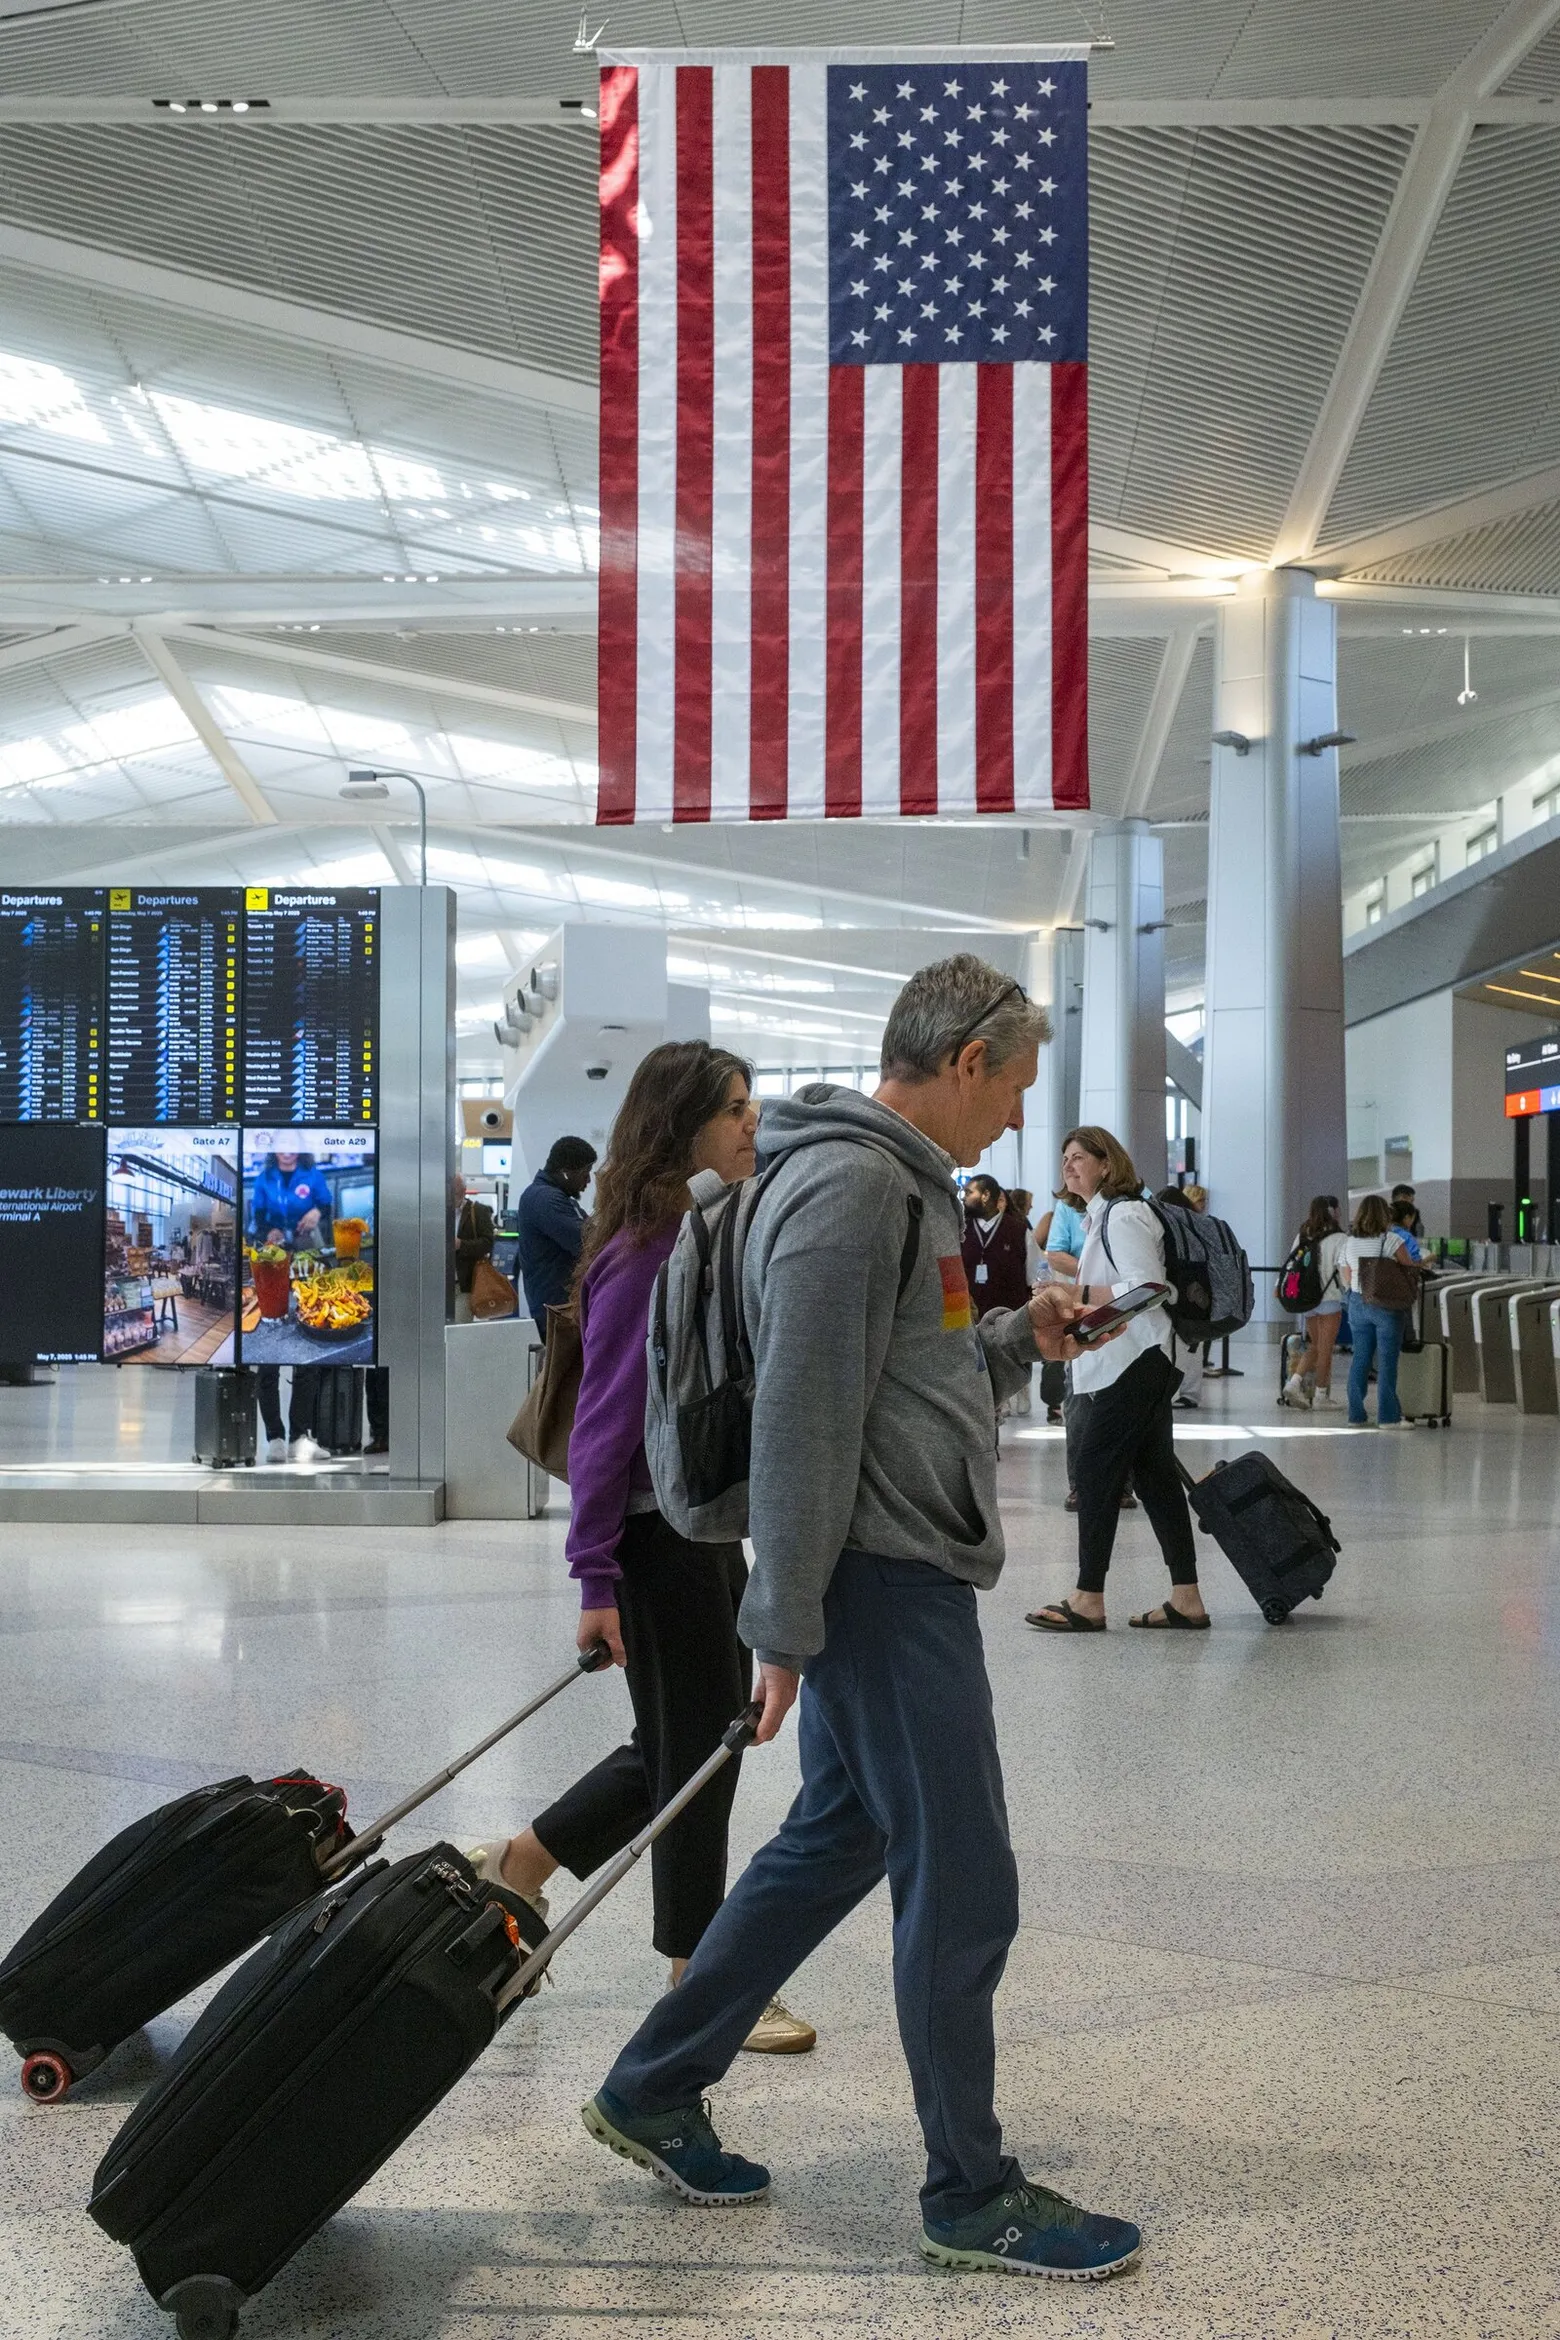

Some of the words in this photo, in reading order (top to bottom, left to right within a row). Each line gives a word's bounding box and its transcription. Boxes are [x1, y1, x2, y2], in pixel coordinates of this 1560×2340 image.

[1, 895, 63, 907] Departures
[137, 895, 199, 907] Departures
[274, 894, 337, 907] Departures
[193, 1137, 215, 1145] Gate
[218, 1137, 231, 1145] A7
[324, 1137, 346, 1146] Gate
[348, 1137, 367, 1146] A29
[45, 1187, 97, 1203] Liberty
[50, 1201, 83, 1213] Airport
[33, 1212, 41, 1221] A
[37, 1353, 49, 1361] May
[57, 1353, 73, 1361] 2025
